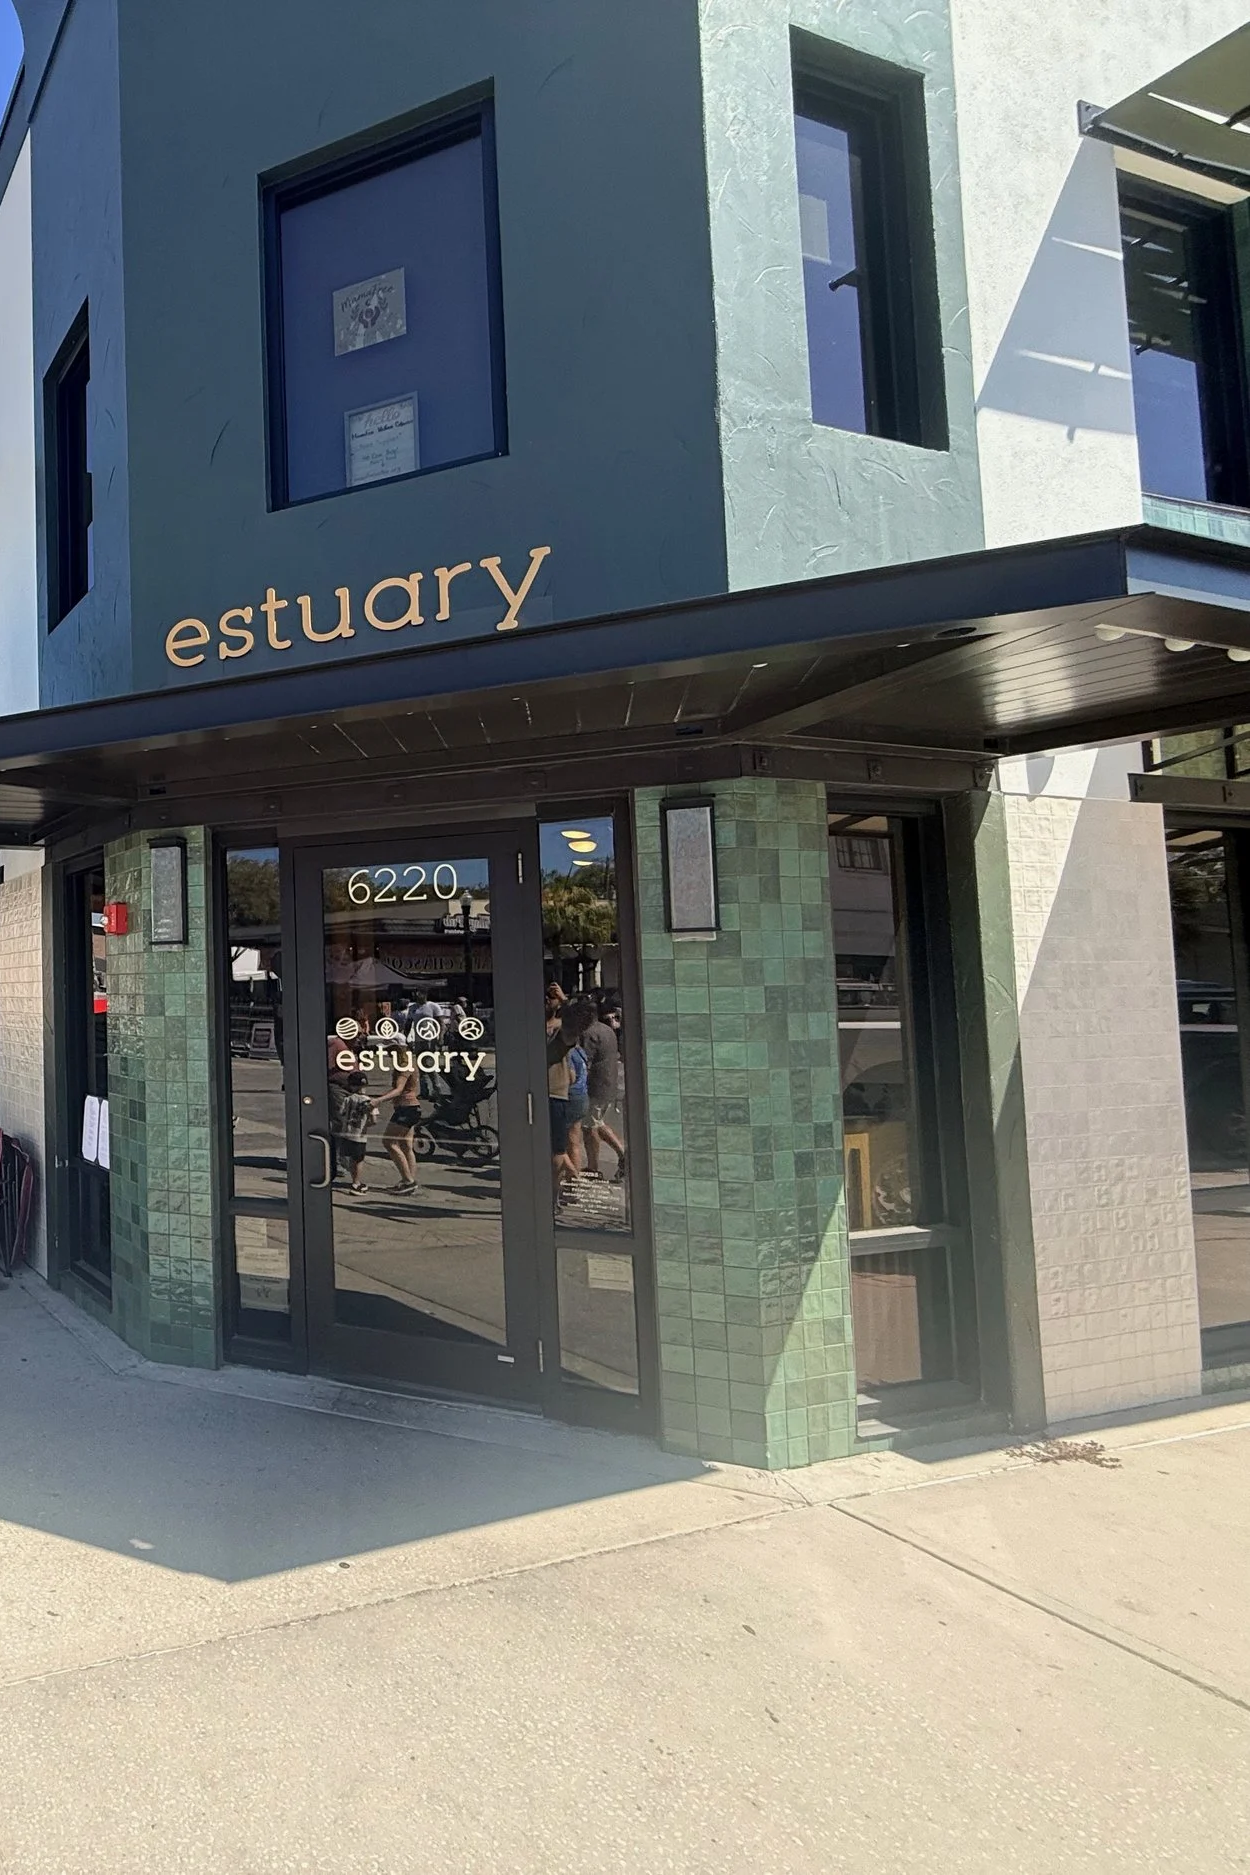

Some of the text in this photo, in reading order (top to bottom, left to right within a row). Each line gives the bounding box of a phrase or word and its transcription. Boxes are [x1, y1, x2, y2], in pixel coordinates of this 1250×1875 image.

[165, 546, 551, 668] estuary
[348, 863, 457, 904] 6220
[335, 1045, 486, 1082] estuary
